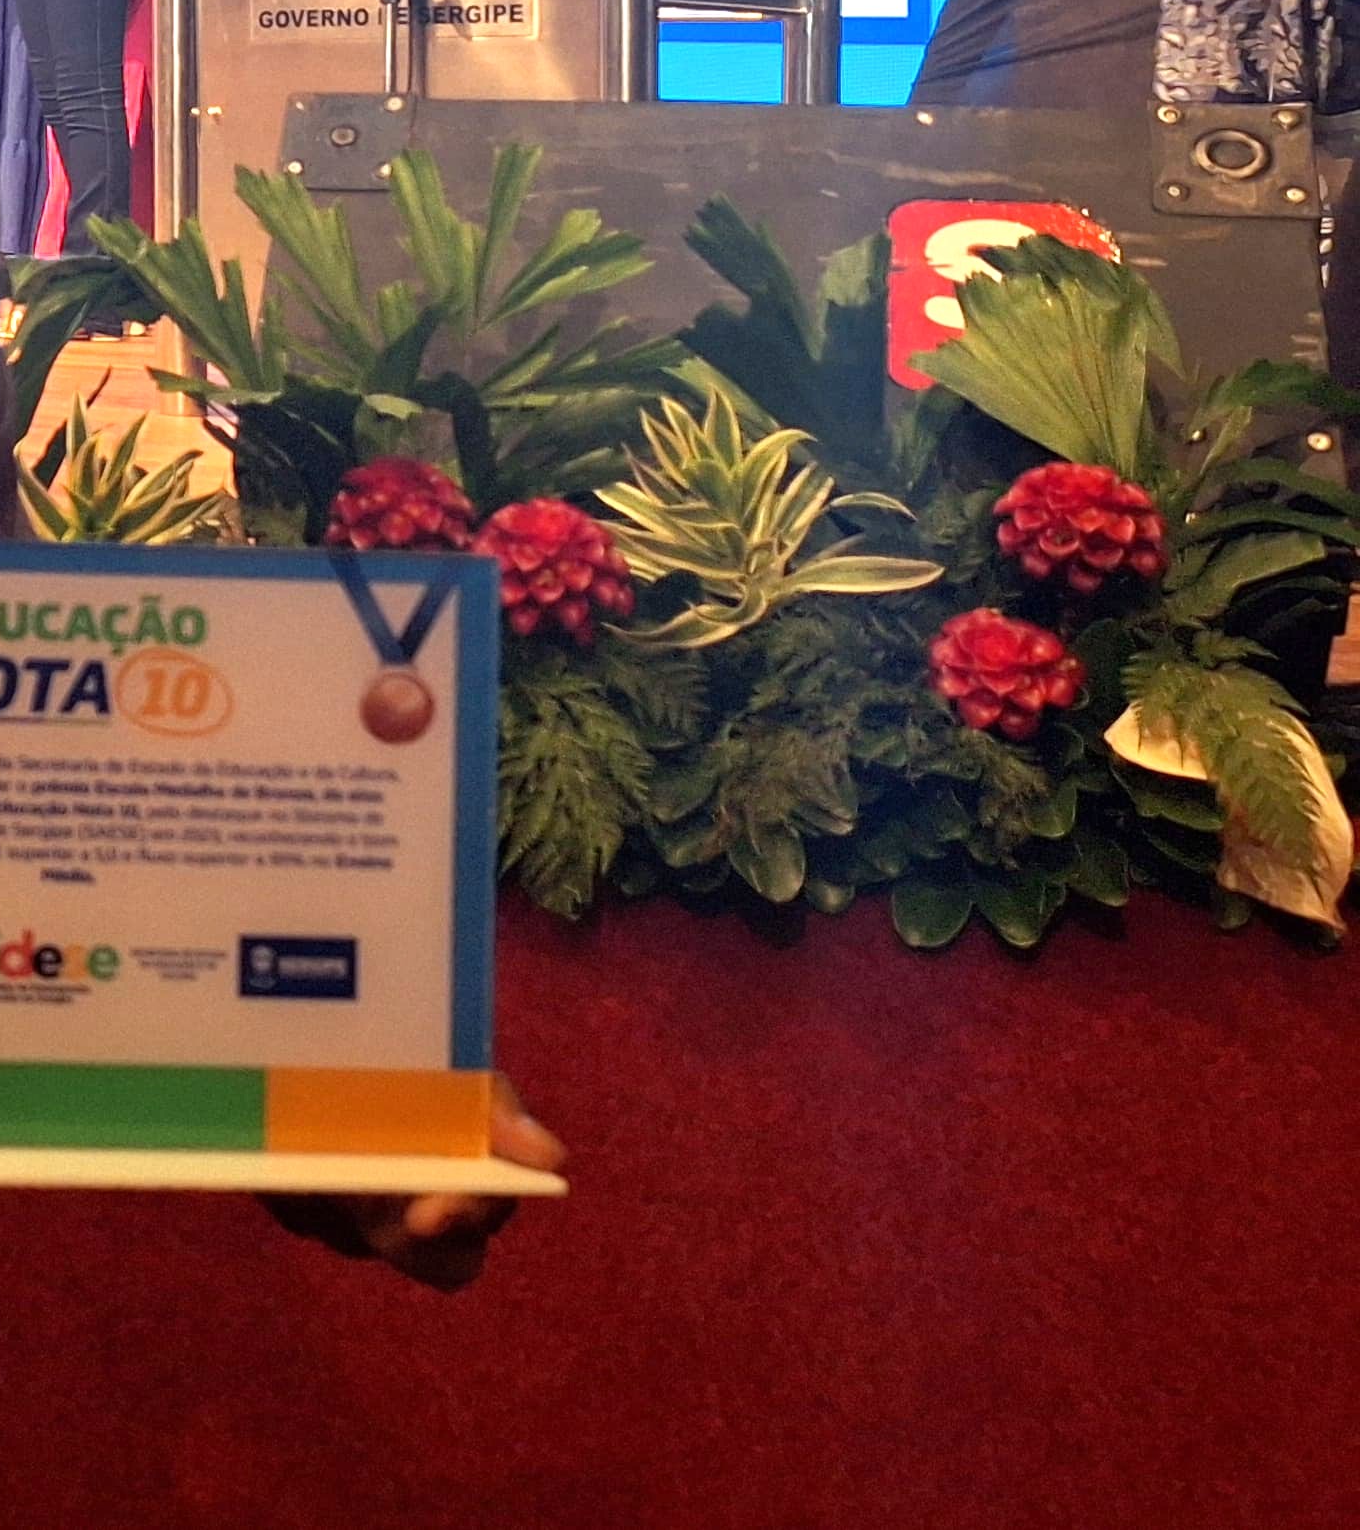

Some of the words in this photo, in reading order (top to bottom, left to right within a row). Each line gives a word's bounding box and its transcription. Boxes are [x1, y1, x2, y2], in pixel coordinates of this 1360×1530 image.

[258, 7, 369, 29] GOVERNO
[415, 3, 524, 25] SERGIPE
[142, 669, 211, 719] 10
